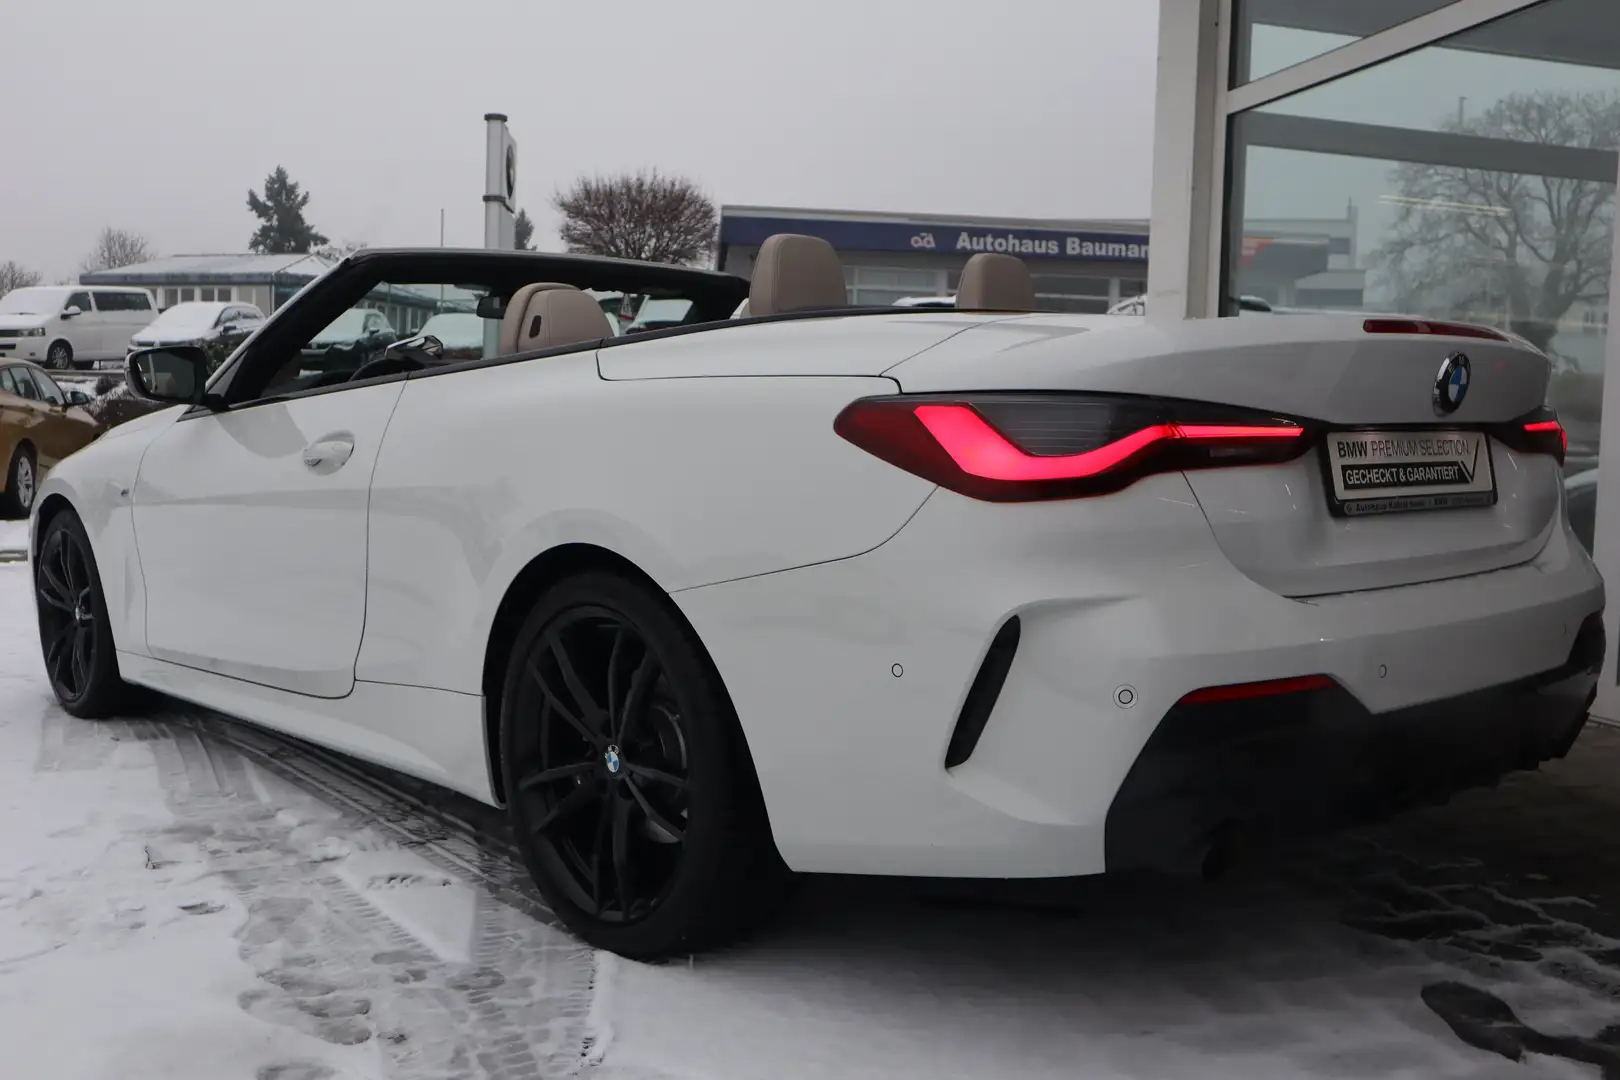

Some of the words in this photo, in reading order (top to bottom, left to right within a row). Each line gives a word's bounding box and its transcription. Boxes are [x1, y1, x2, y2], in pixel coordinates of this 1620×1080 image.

[956, 231, 1060, 254] Autohaus
[1066, 236, 1149, 259] Bauman
[1337, 441, 1368, 458] BMW
[1370, 440, 1418, 457] PREMIUM
[1418, 439, 1470, 457] SELECTION
[1345, 468, 1398, 485] GECHECKT
[1399, 468, 1406, 481] &
[1406, 466, 1460, 482] GARANTIERT
